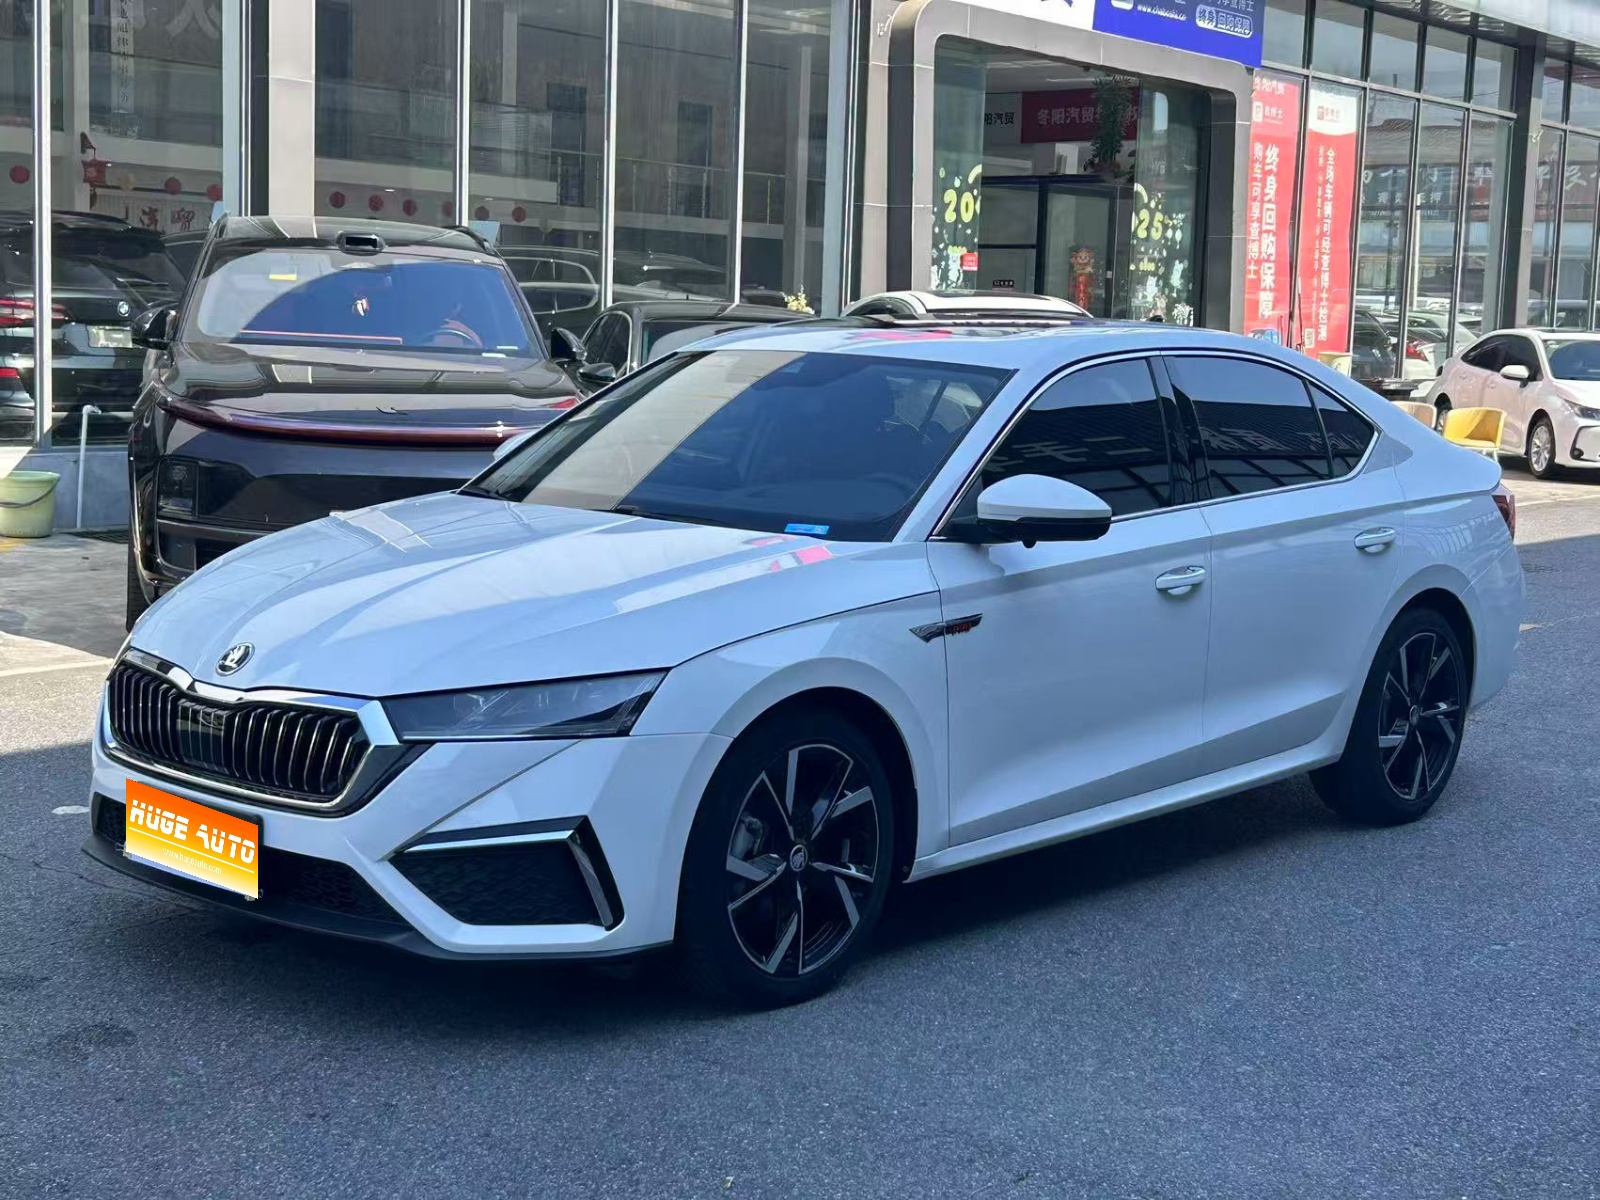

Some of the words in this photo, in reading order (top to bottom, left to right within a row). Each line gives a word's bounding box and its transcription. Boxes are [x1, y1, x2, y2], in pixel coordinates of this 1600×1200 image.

[1258, 144, 1279, 318] 终身回购保障
